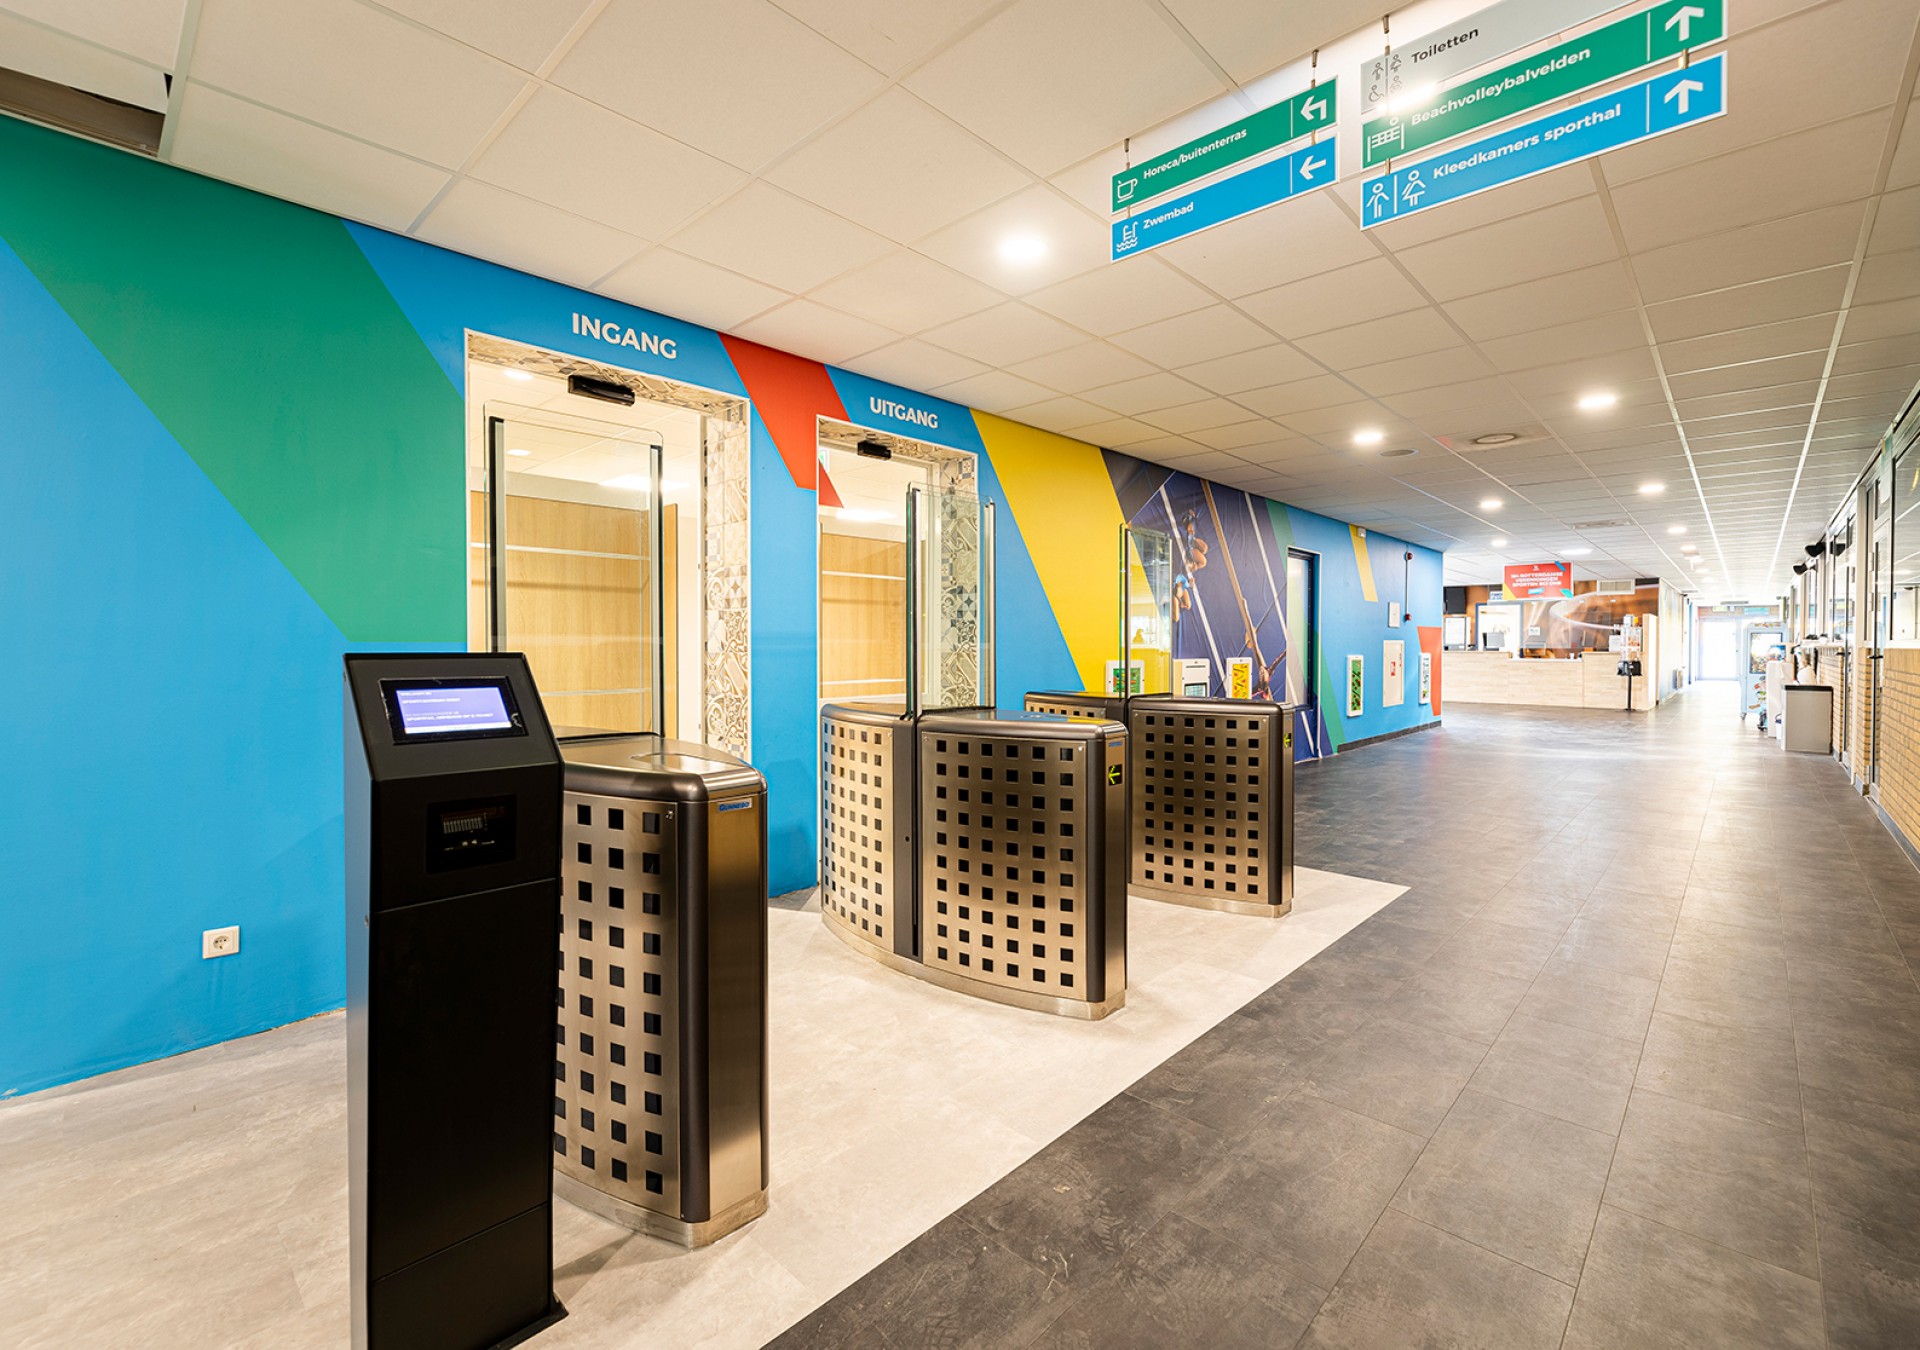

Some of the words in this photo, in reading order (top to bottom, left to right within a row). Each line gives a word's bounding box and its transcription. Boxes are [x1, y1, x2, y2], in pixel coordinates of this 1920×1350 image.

[1411, 28, 1480, 64] Toiletten
[1411, 48, 1591, 127] Beachvolleybalvelden
[1142, 128, 1247, 180] Horeca/buitenterras
[1432, 134, 1540, 179] Kleedkamers
[1543, 103, 1622, 142] sporthal
[1142, 201, 1194, 230] Zwembad
[572, 313, 678, 360] INGANG
[869, 397, 939, 429] UITGANG
